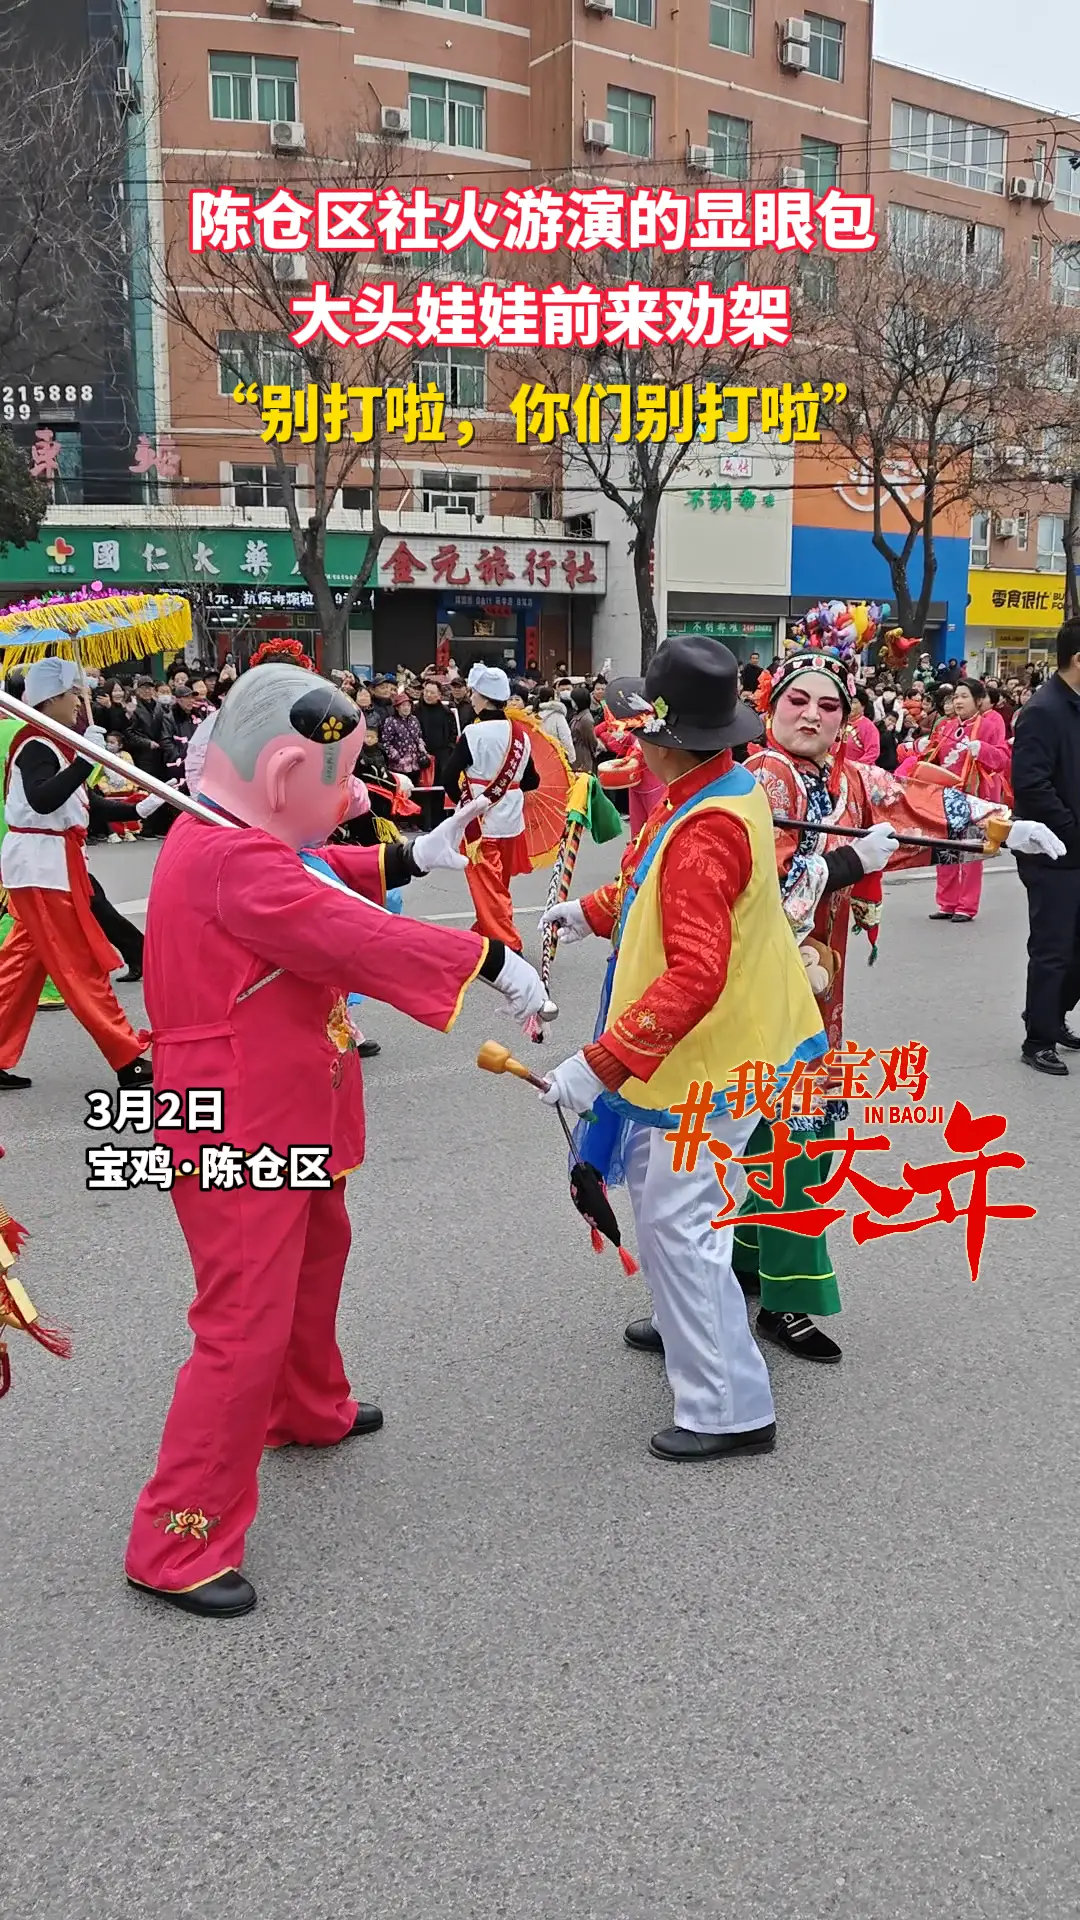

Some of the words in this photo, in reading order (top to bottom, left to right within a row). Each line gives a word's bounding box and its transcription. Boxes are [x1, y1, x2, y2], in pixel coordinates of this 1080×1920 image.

[2, 385, 93, 402] 215888
[3, 404, 31, 420] 99
[92, 540, 301, 576] 國仁大藥
[381, 541, 598, 590] 金元旅行社
[992, 589, 1050, 610] 零食很忙
